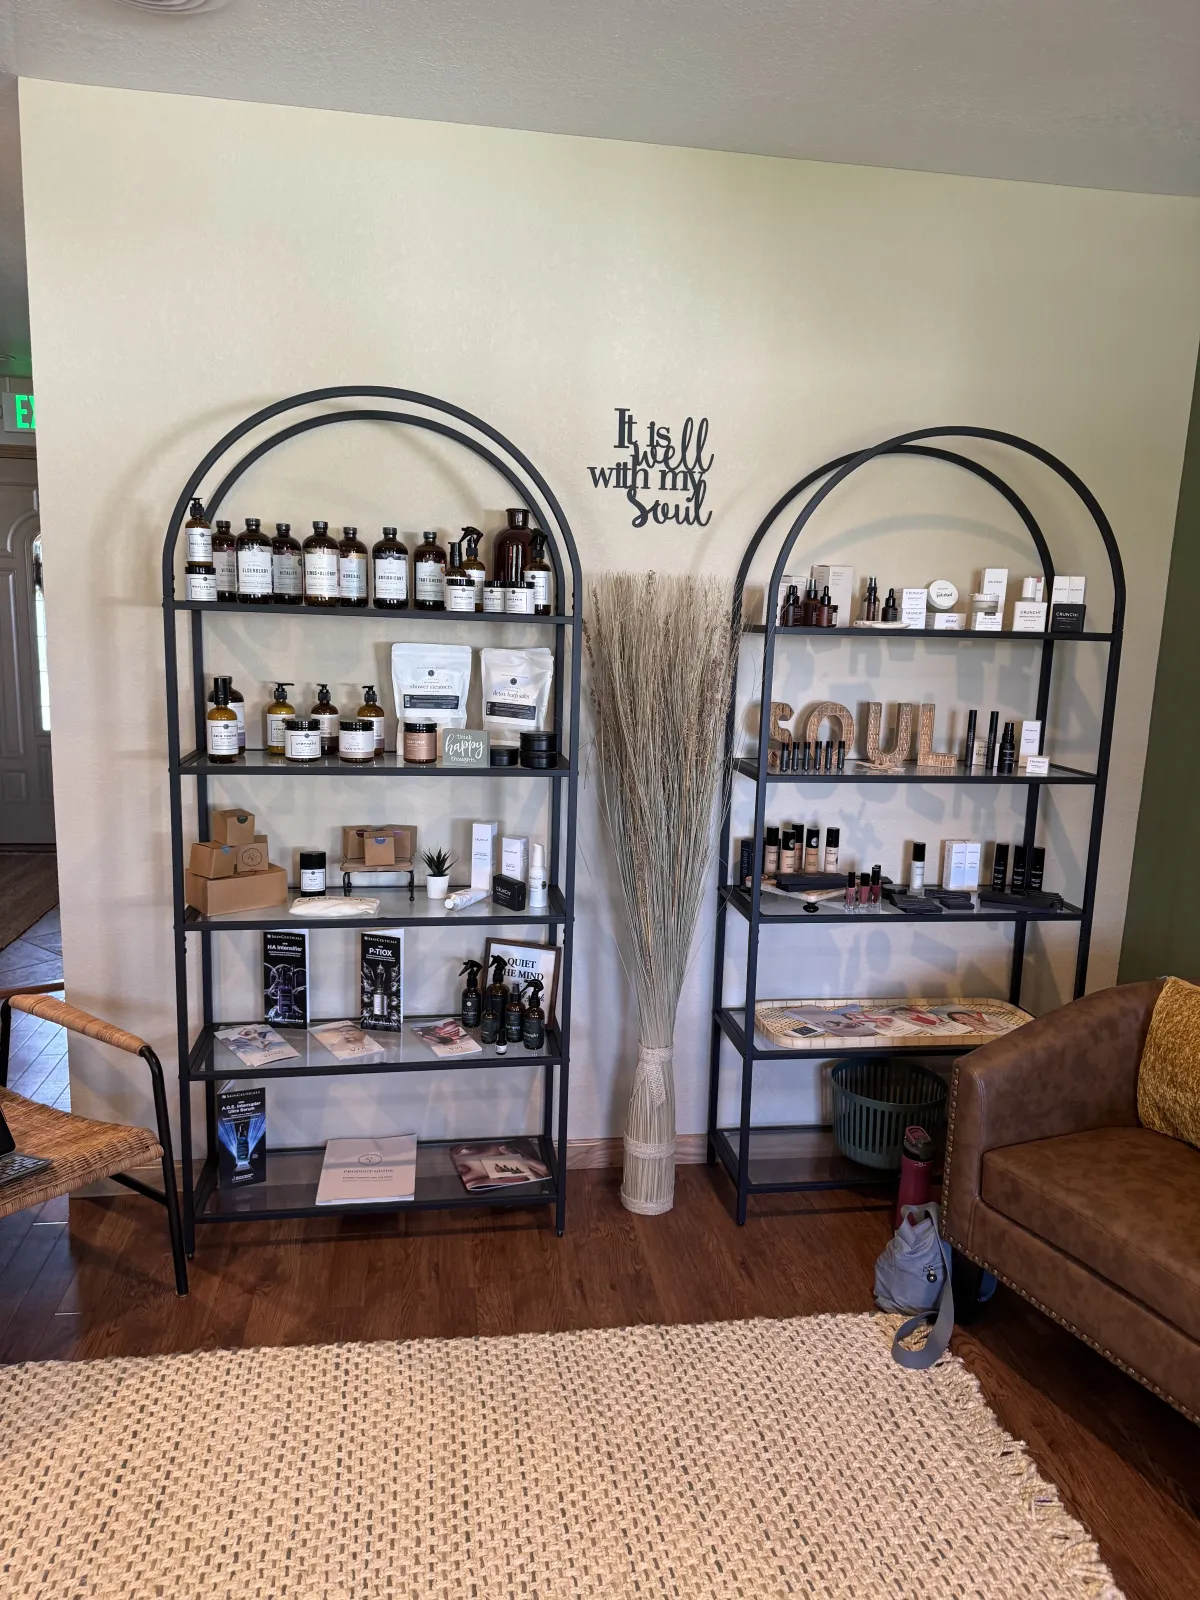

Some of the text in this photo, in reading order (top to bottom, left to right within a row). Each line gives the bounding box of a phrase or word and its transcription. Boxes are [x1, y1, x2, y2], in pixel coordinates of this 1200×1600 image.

[613, 407, 672, 449] It is
[632, 416, 715, 472] well
[586, 454, 706, 503] with my
[445, 733, 485, 760] happy
[768, 701, 957, 768] SOUL
[368, 947, 393, 957] P-TIOX
[507, 957, 537, 969] QUIET
[502, 968, 545, 981] HE MIND
